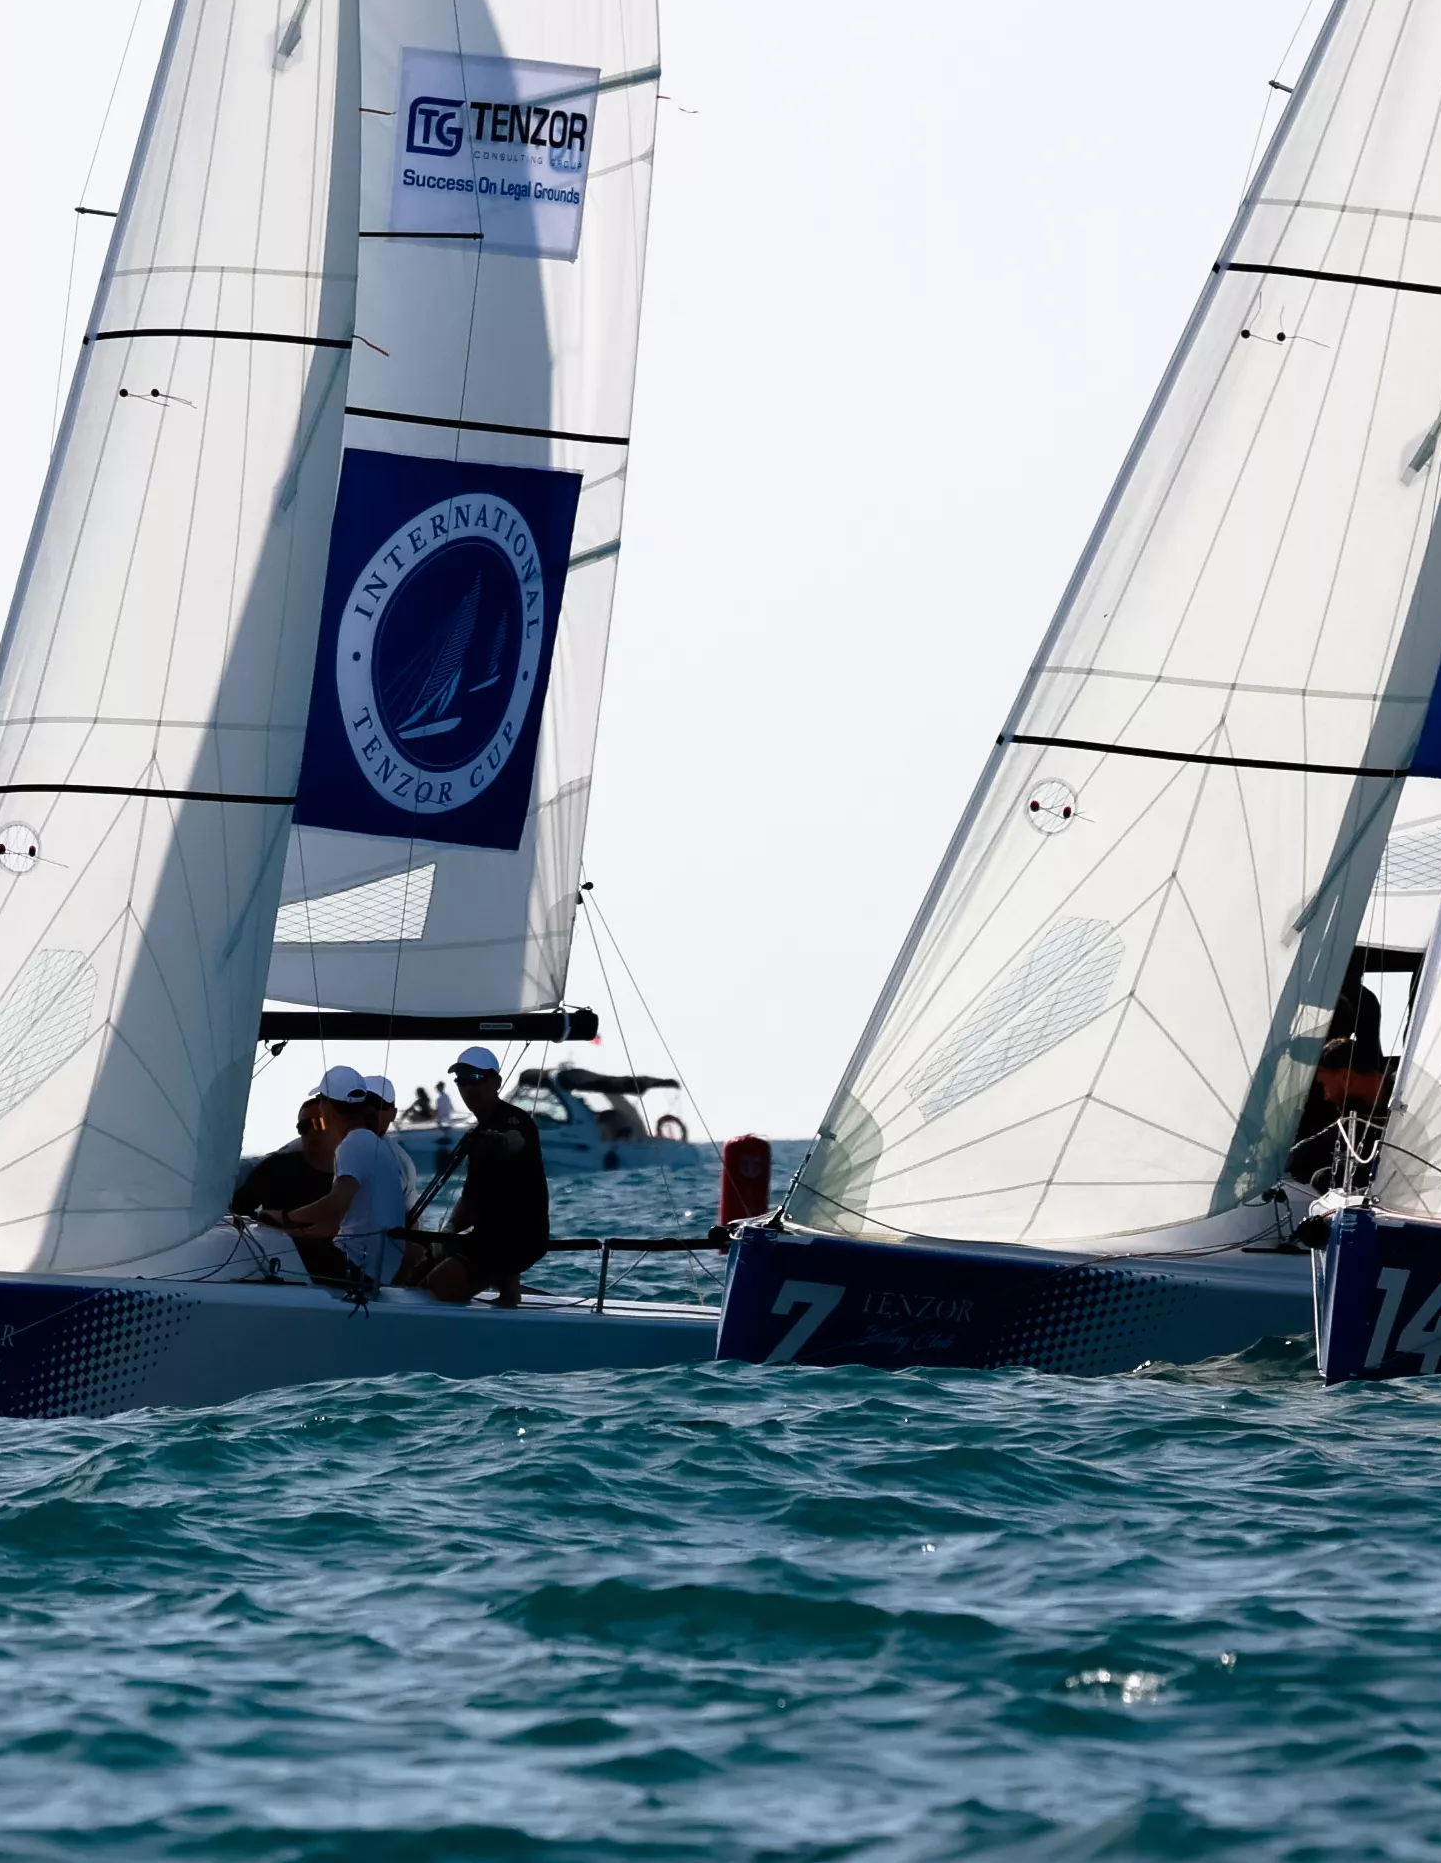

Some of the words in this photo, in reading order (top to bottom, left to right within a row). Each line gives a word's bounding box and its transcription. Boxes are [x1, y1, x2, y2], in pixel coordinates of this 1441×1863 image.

[471, 102, 588, 152] TENZOR
[473, 150, 543, 164] CONSULTING
[402, 169, 474, 192] Success
[479, 176, 496, 194] On
[500, 178, 530, 201] Legal
[534, 182, 580, 205] Grounds
[353, 502, 541, 640] INTERNATIONAL
[351, 706, 453, 805] TENZOR
[469, 720, 516, 788] CUP
[765, 1279, 846, 1363] 7
[862, 1290, 976, 1323] TENZOR
